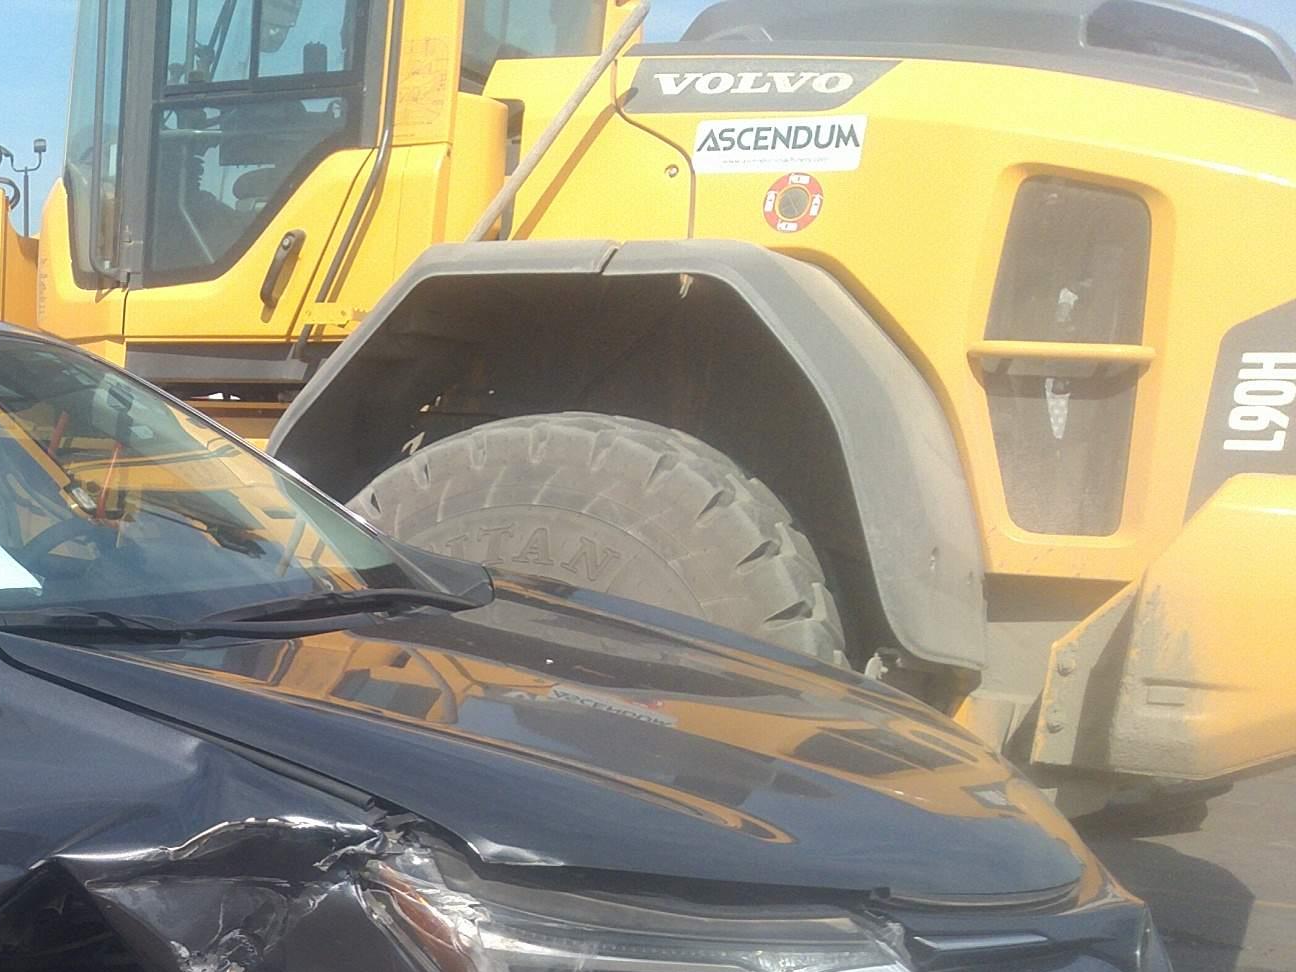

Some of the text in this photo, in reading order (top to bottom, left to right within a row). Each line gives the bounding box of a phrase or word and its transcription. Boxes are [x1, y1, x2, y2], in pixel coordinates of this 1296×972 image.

[654, 72, 854, 95] VOLVO
[696, 124, 860, 152] ASCENDUM
[426, 525, 621, 582] ITAN
